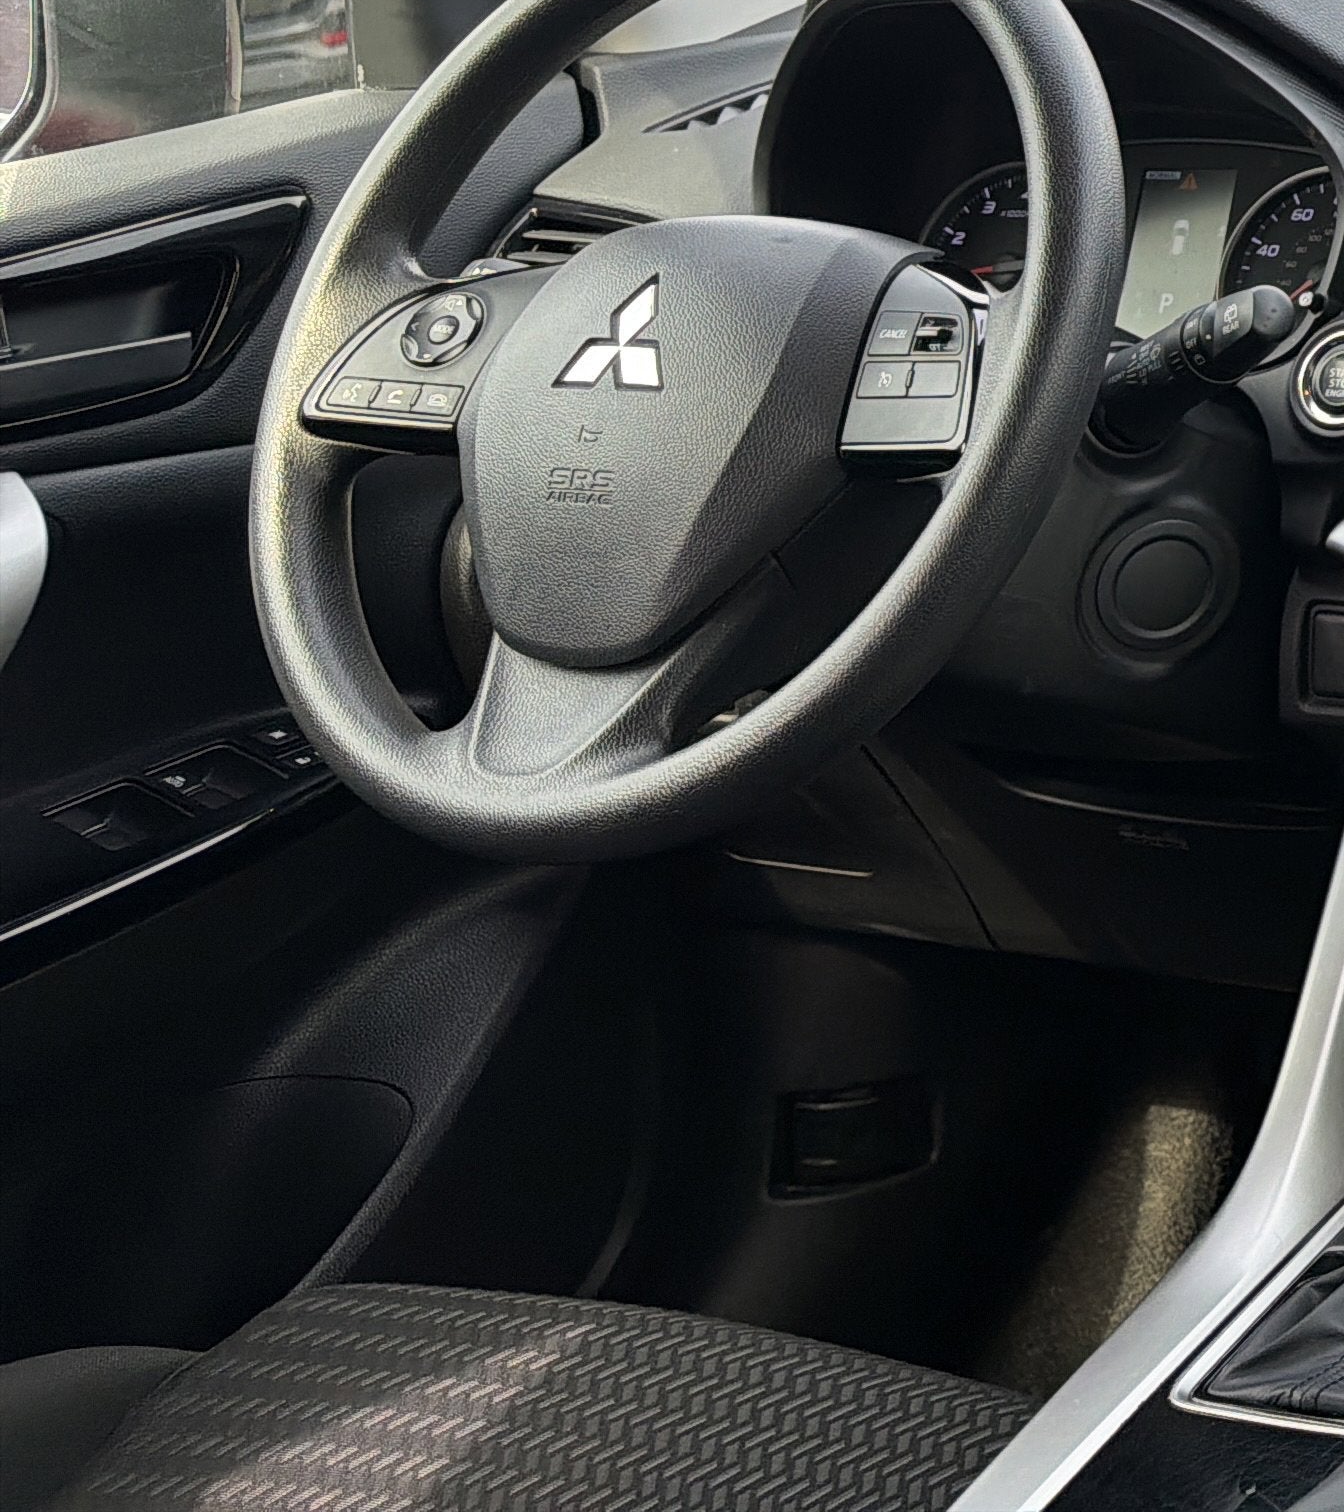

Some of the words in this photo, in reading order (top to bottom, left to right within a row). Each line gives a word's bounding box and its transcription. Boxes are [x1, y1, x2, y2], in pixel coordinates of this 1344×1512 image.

[980, 200, 997, 215] 3
[1290, 208, 1315, 222] 60
[950, 231, 966, 246] 2
[1255, 244, 1280, 258] 40
[1159, 292, 1175, 314] P
[879, 328, 908, 339] CANCEL
[548, 467, 614, 488] SRS
[546, 490, 614, 505] AIRBAG
